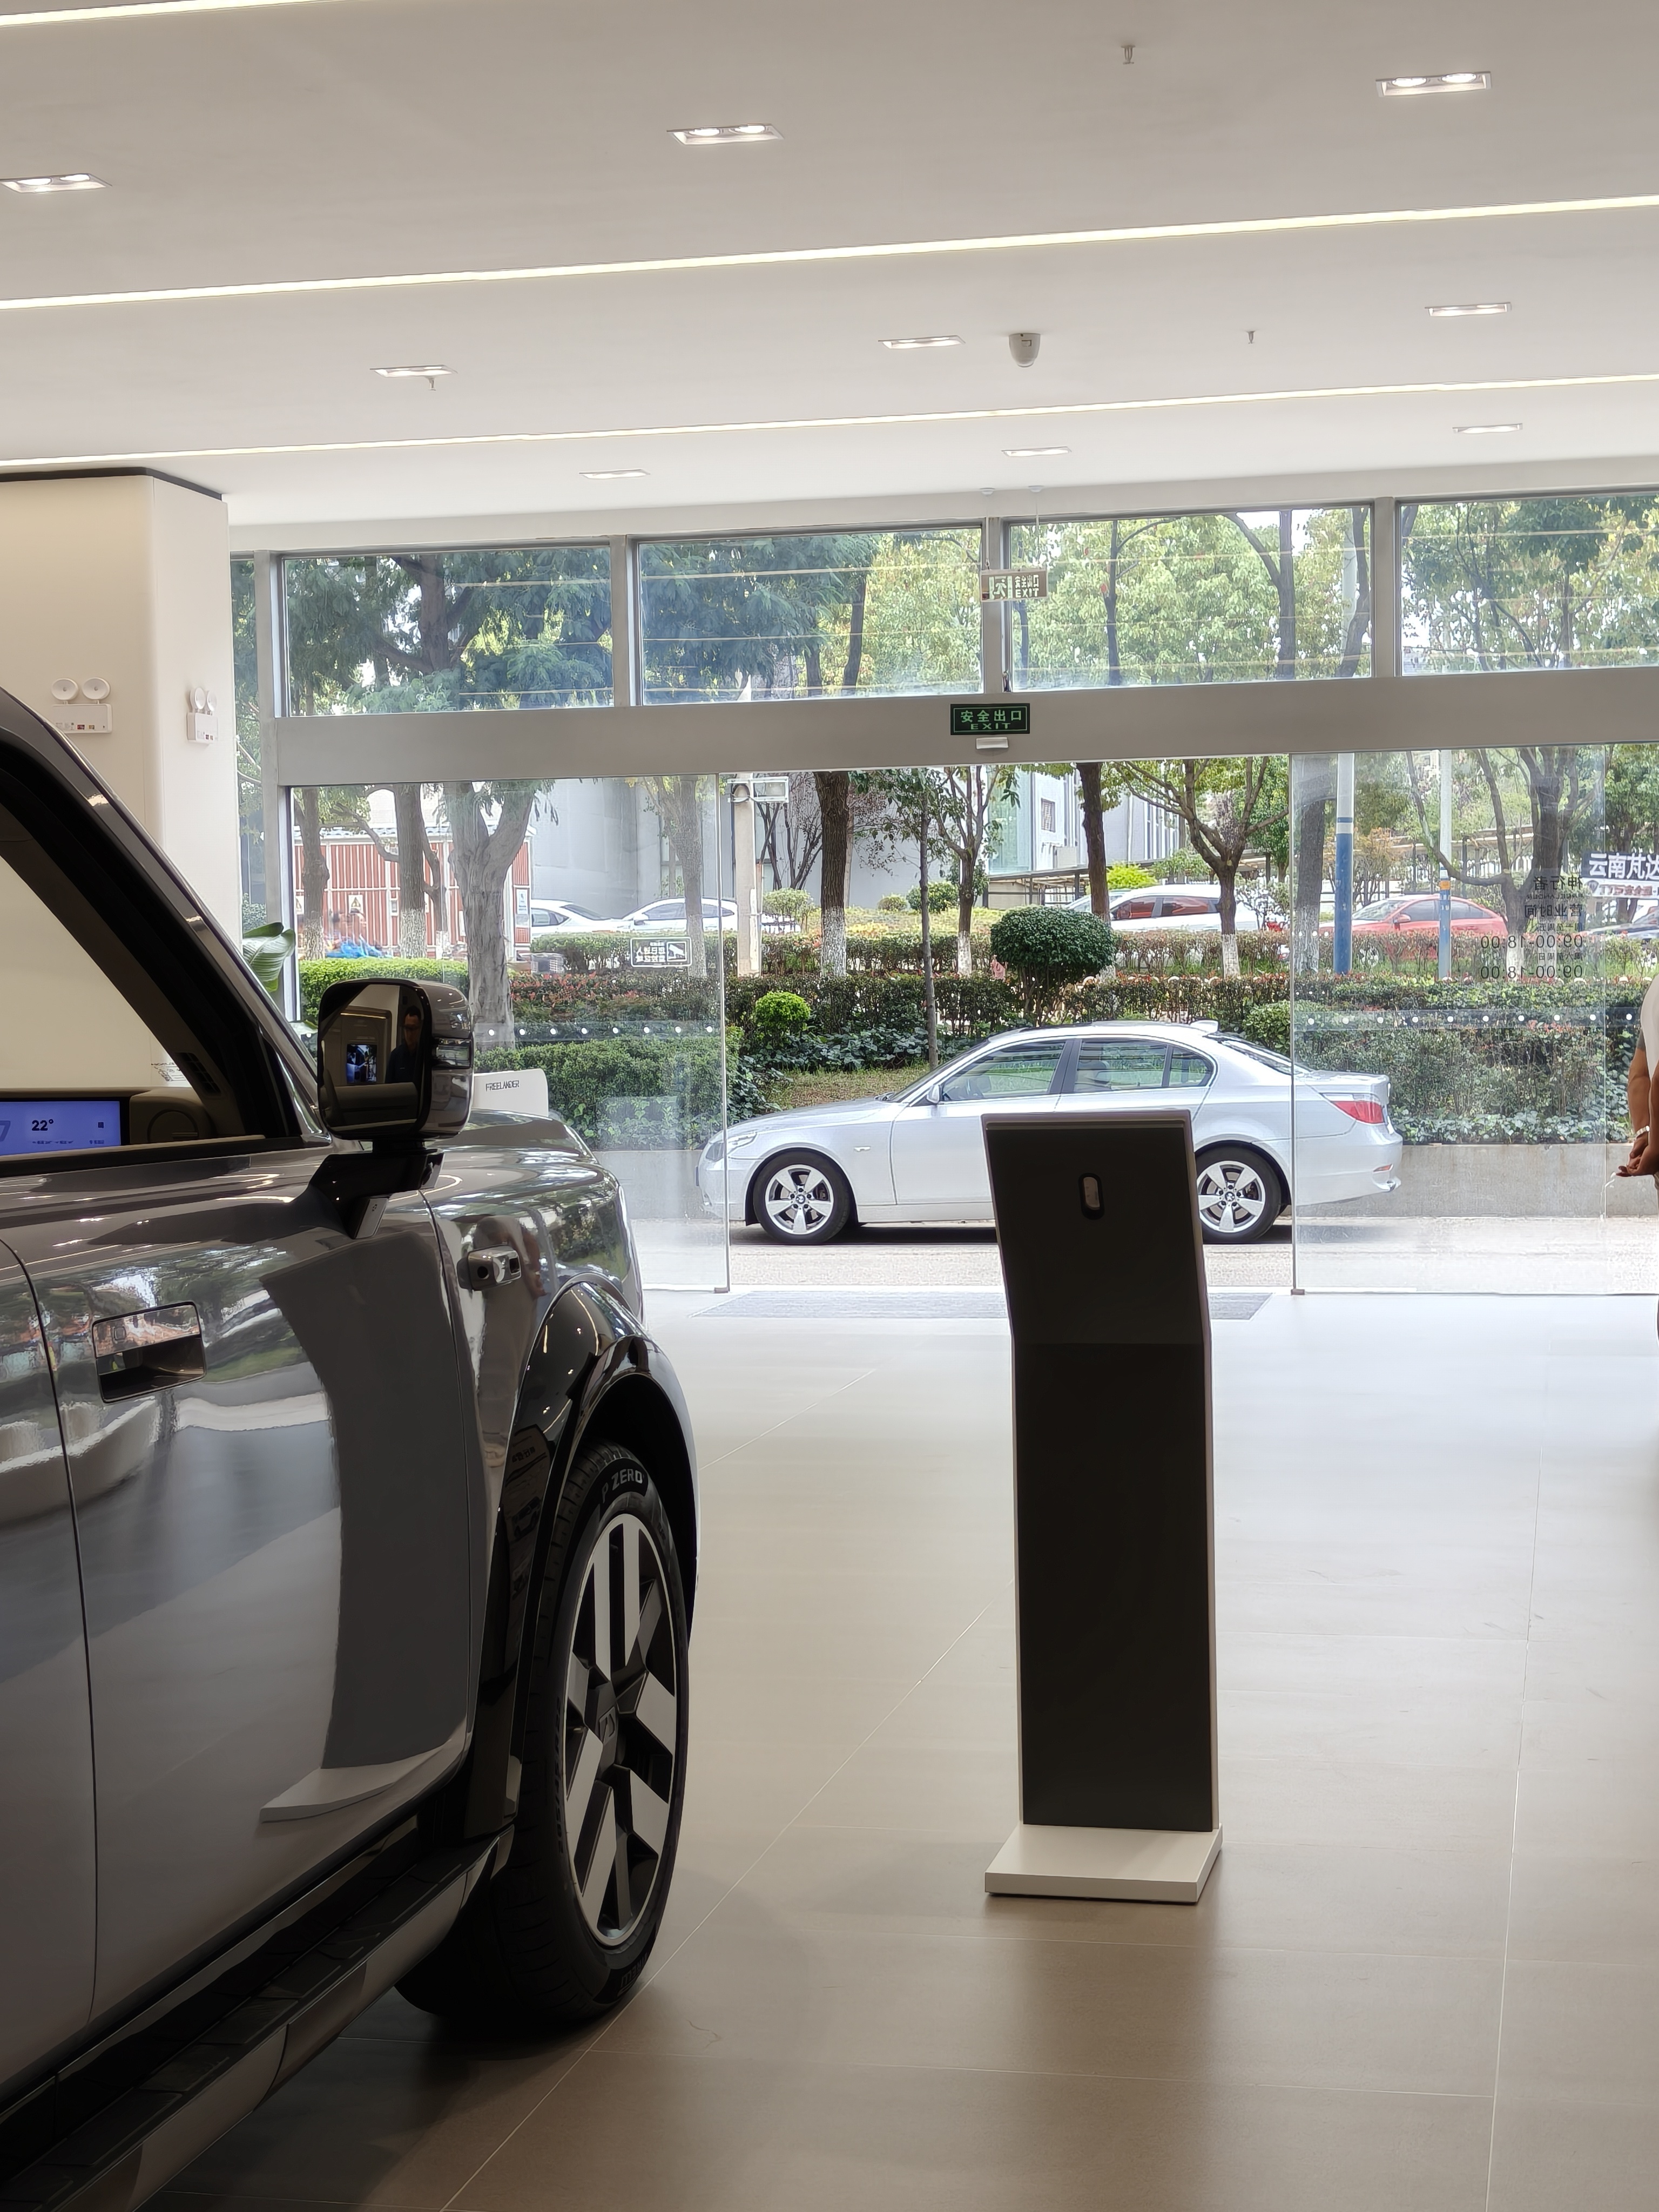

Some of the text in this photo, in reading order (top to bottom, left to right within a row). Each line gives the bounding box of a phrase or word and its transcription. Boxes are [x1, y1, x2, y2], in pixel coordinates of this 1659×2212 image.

[1015, 588, 1039, 598] EXIT
[961, 710, 1021, 723] 安全出口
[485, 1080, 520, 1091] FREELANDER
[31, 1118, 54, 1131] 22°
[602, 1468, 643, 1503] P ZERO
